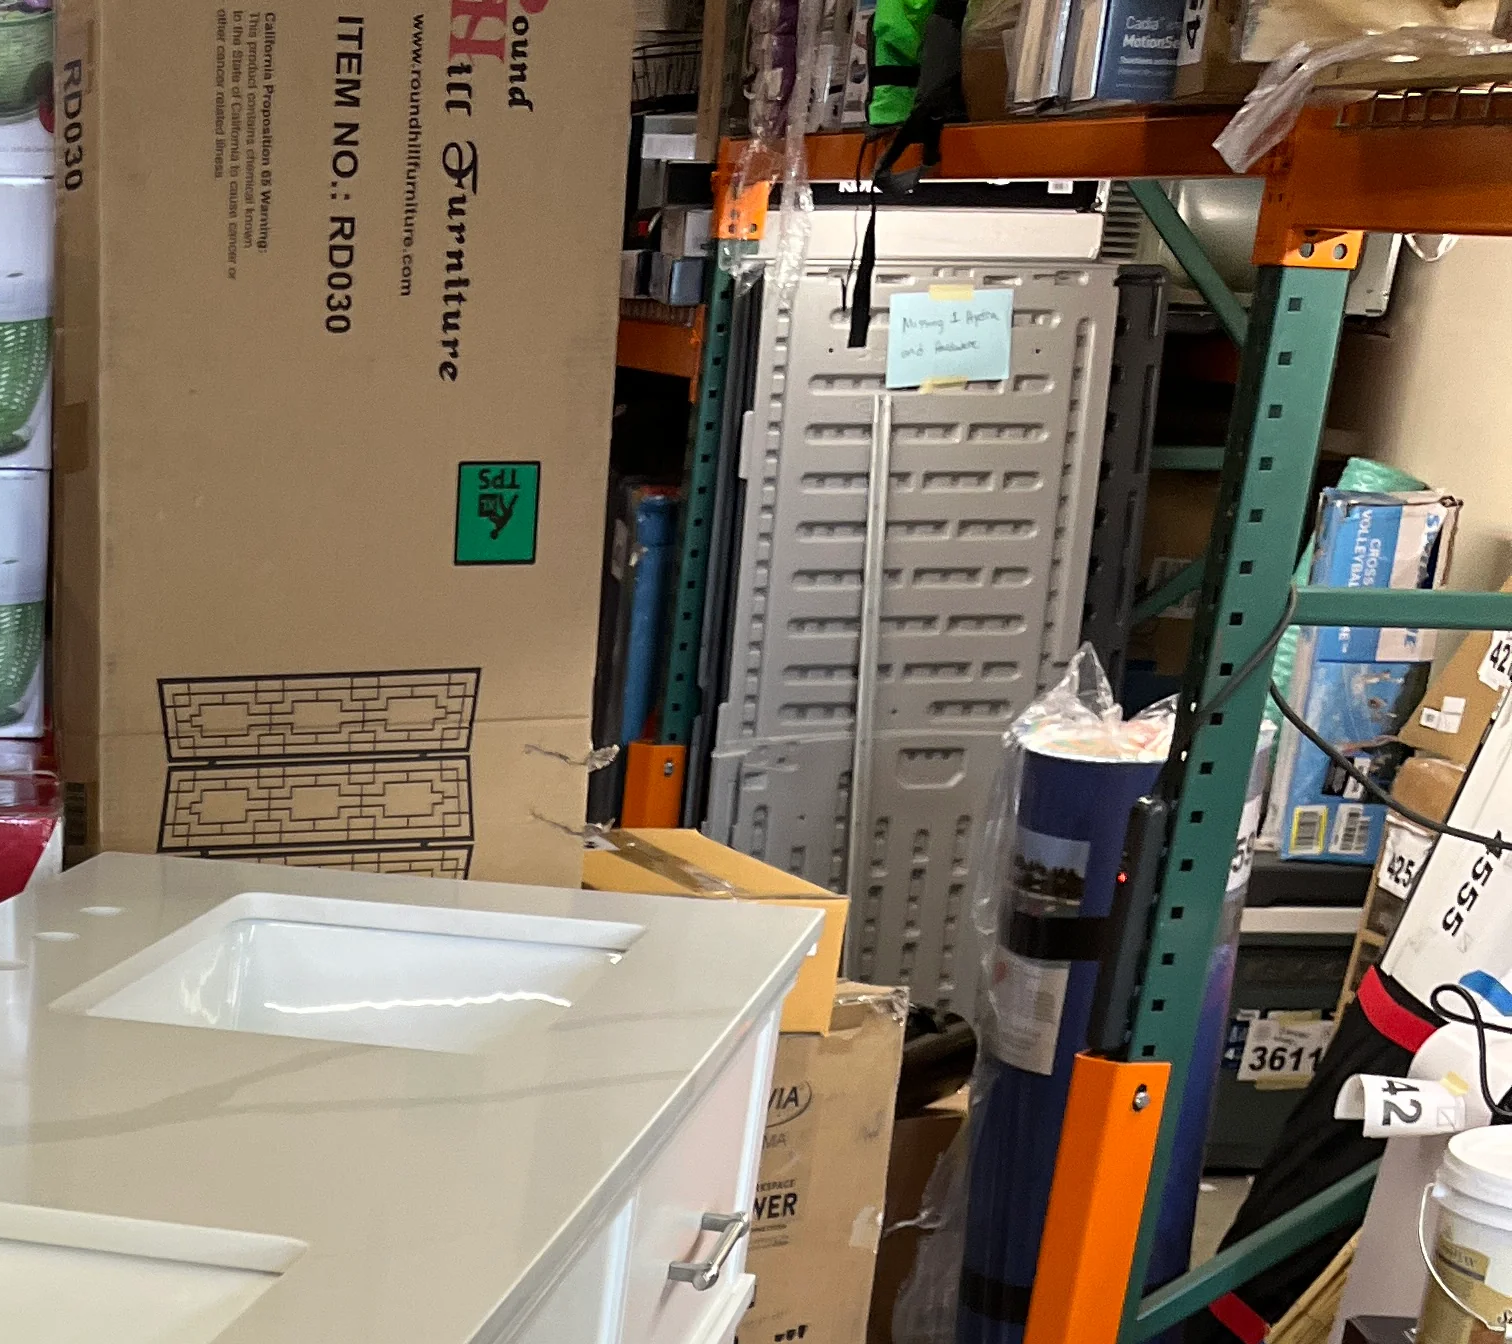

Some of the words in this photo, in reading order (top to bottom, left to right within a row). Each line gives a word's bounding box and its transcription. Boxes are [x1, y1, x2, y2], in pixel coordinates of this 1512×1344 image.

[334, 16, 365, 108] ITEM
[64, 59, 83, 191] RD030
[262, 84, 275, 166] Proposition
[330, 122, 360, 200] NO.:
[400, 14, 424, 296] www.roundhillfurniture.com
[325, 216, 356, 334] RD030
[438, 141, 478, 382] Furniture
[479, 468, 521, 490] TPS
[1348, 508, 1373, 588] VOLLEYBAL
[1363, 538, 1381, 587] CROSS
[1248, 1046, 1324, 1073] 3611
